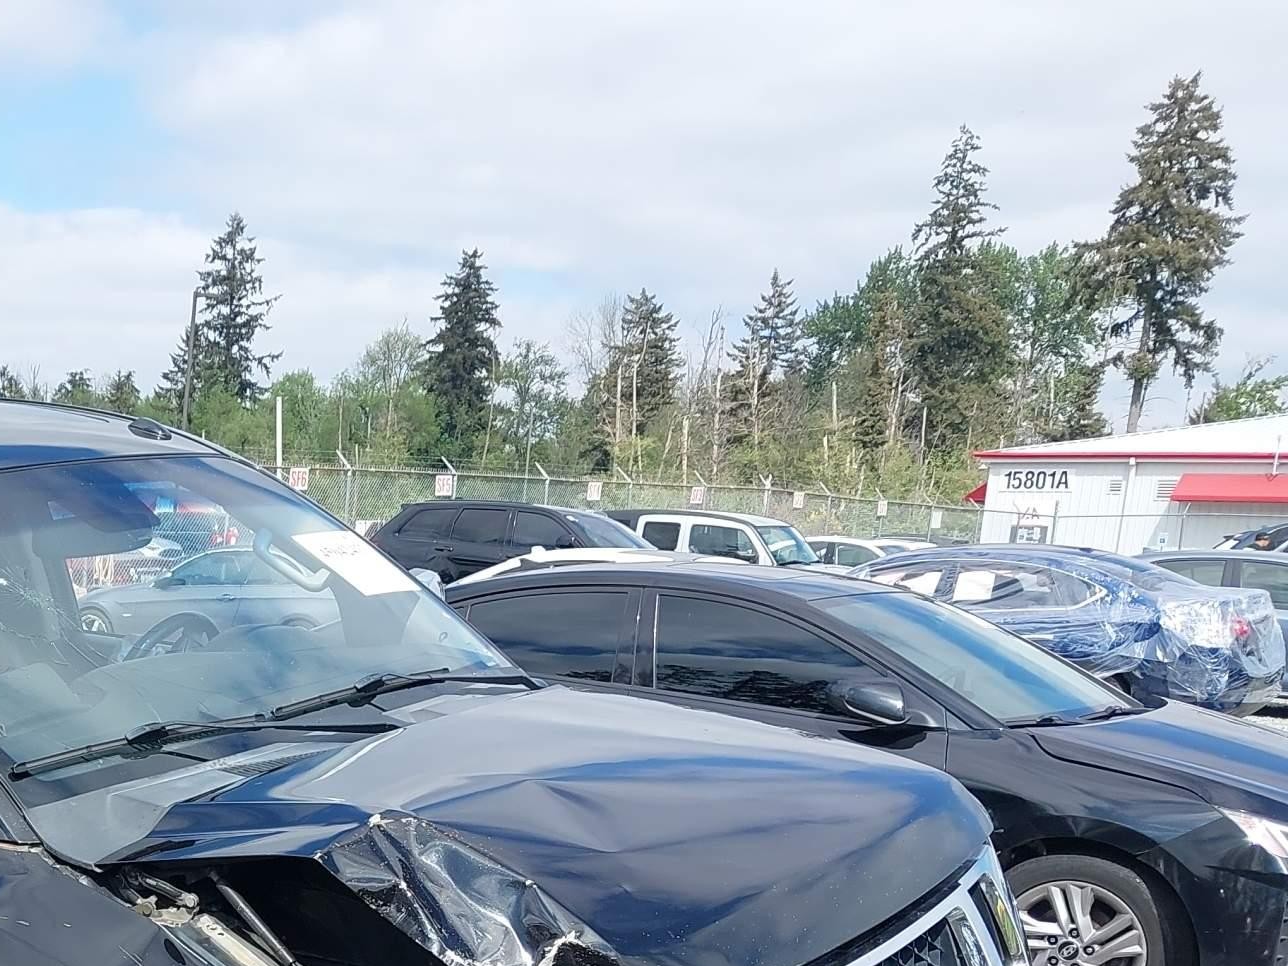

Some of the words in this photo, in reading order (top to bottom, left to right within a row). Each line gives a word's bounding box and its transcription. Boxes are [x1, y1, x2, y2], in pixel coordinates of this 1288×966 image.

[289, 470, 308, 487] SF6
[436, 478, 452, 494] SF5
[1004, 470, 1069, 490] 15801A
